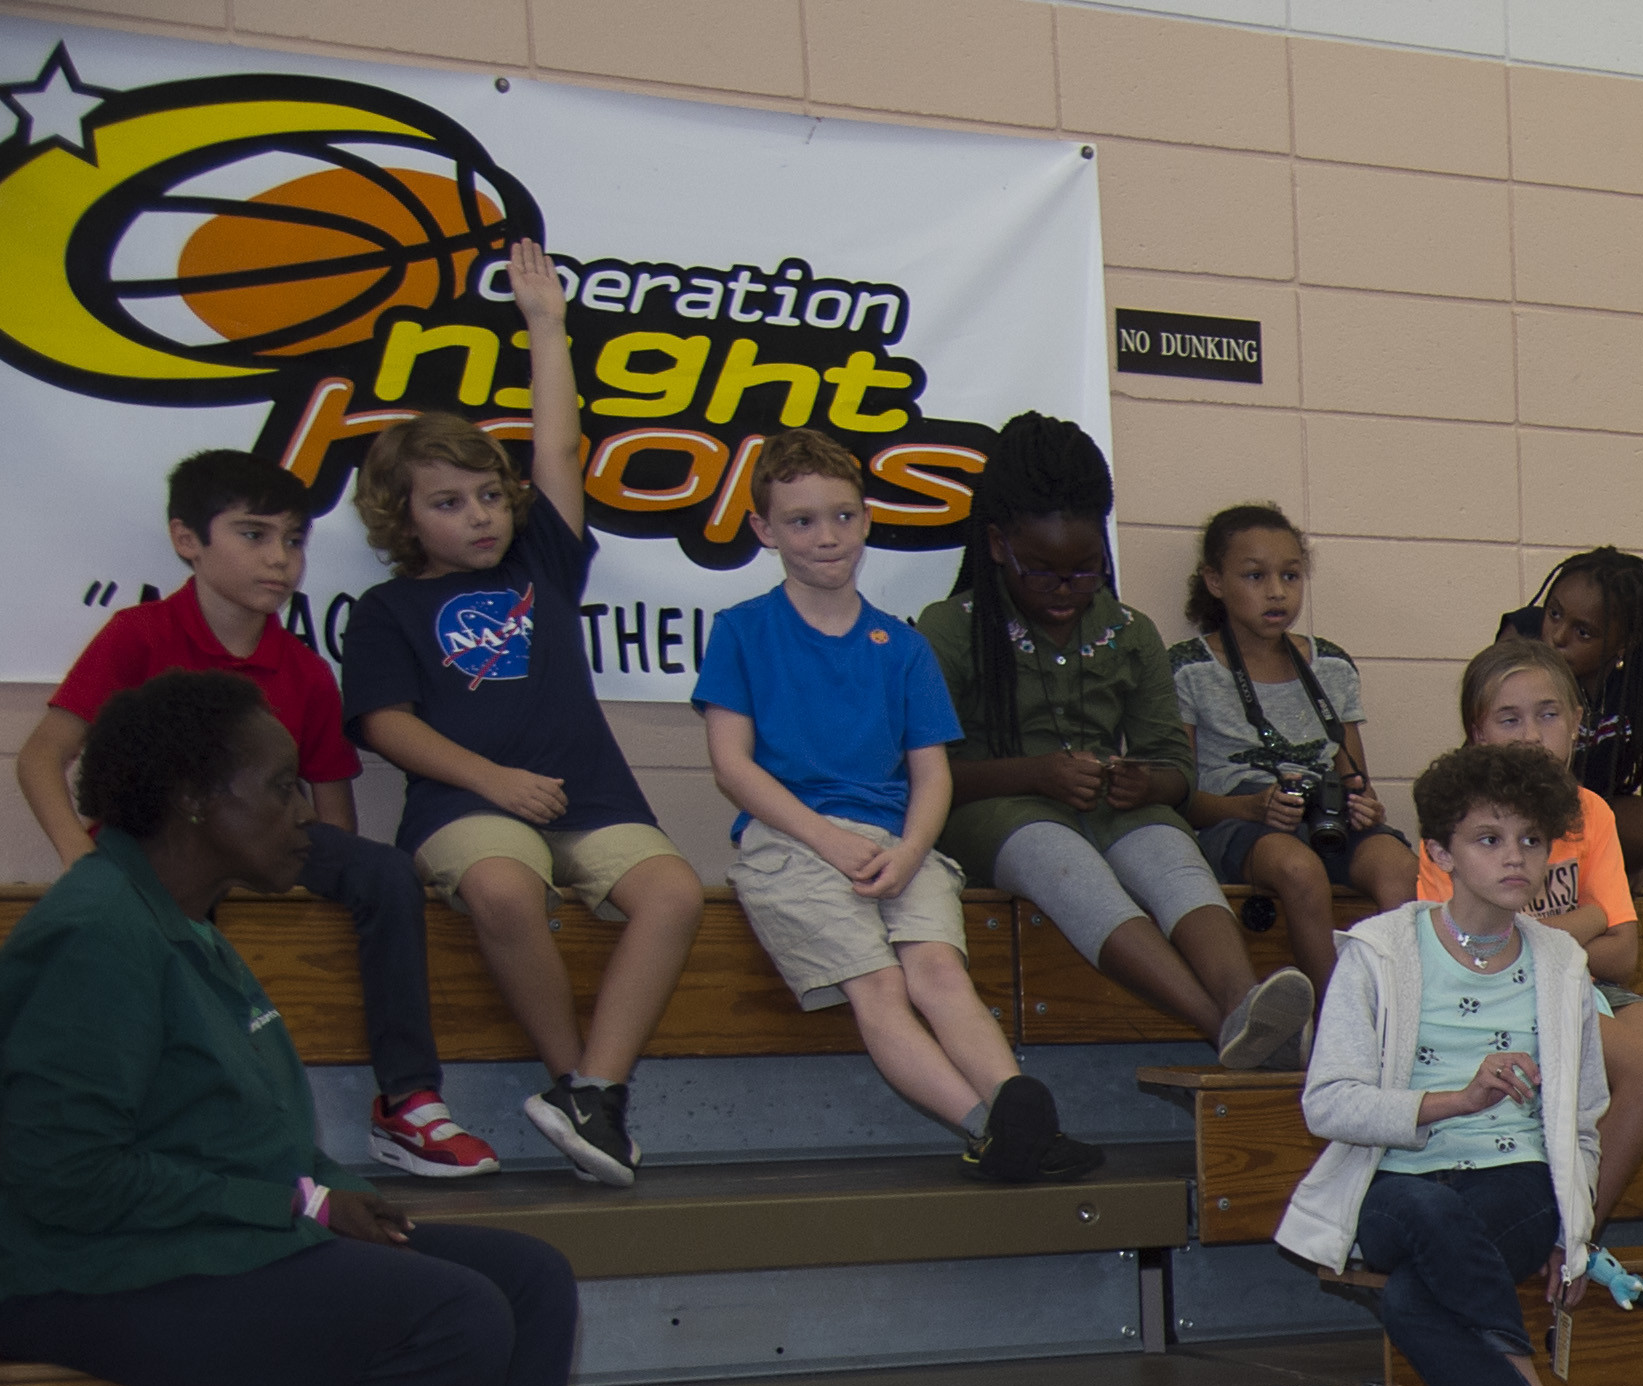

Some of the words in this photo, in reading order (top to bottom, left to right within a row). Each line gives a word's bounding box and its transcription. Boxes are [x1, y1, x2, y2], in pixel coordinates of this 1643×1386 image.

[1120, 328, 1151, 354] NO
[1160, 331, 1259, 364] DUNKING
[445, 614, 535, 653] NASA
